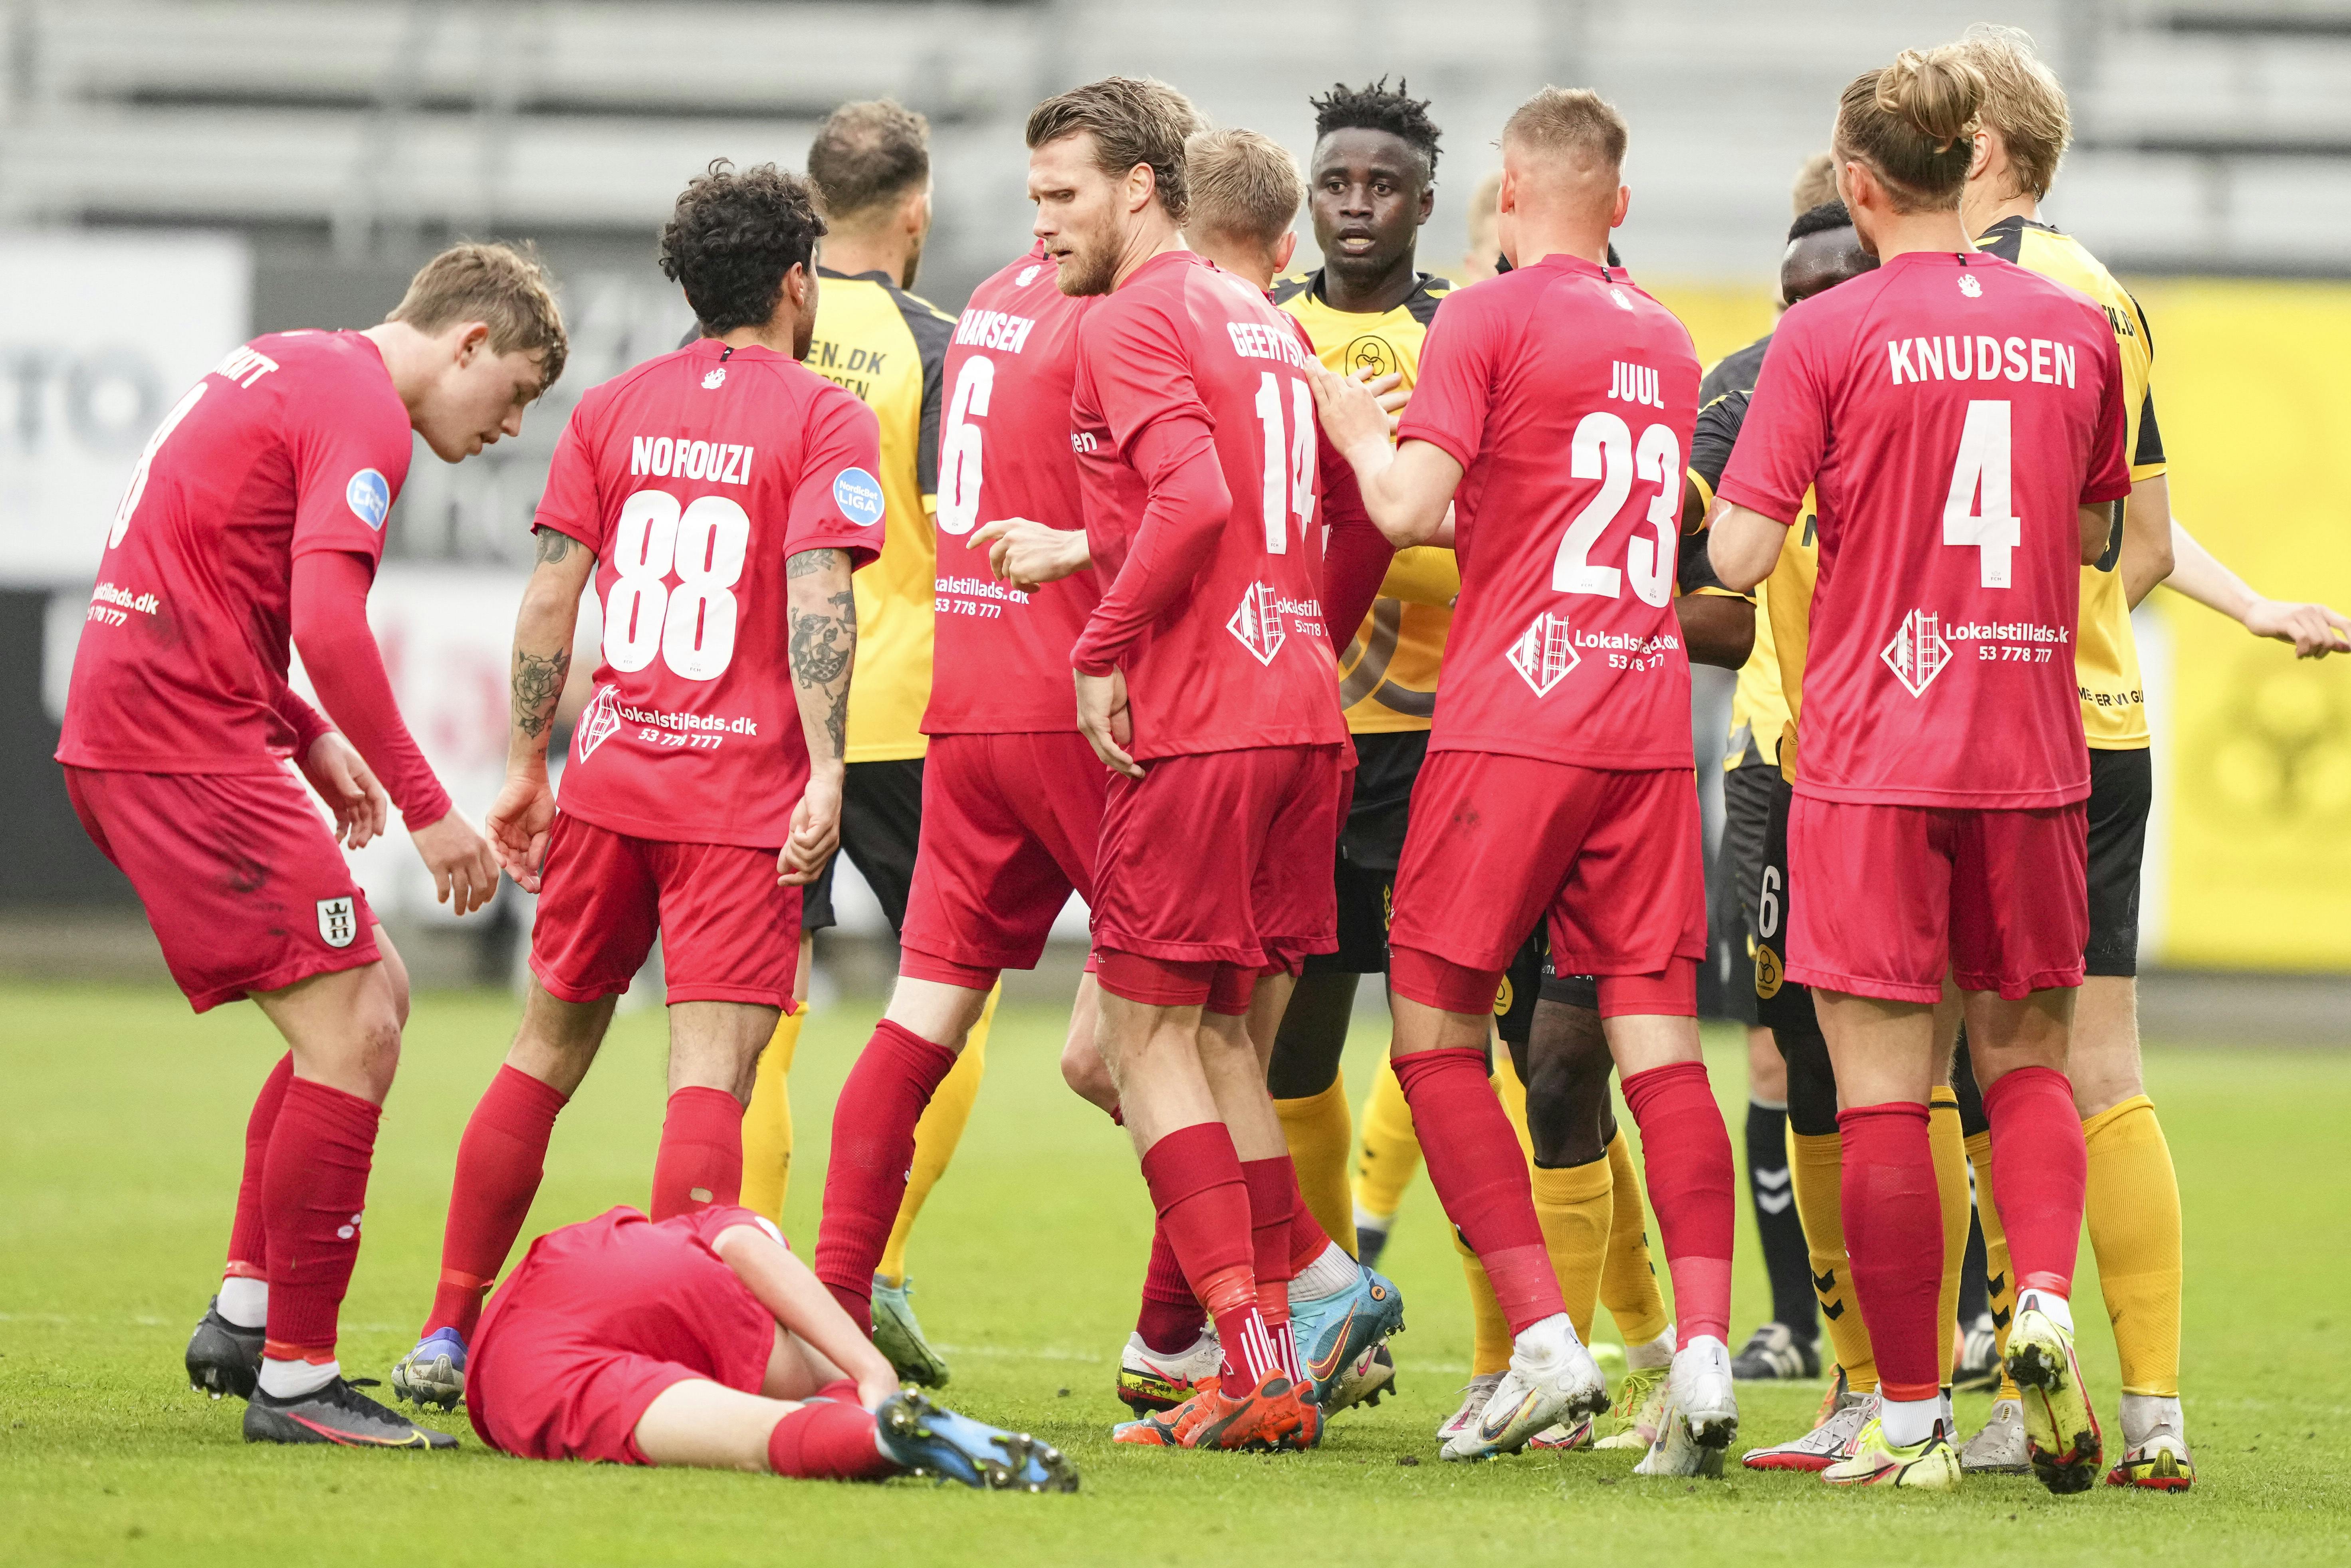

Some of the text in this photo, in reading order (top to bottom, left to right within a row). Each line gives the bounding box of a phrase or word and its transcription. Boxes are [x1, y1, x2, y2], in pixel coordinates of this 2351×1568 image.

[955, 309, 1035, 354] HANSEN
[1608, 360, 1664, 410] JUUL
[1888, 336, 2075, 389] KNUDSEN
[936, 355, 994, 535] 6
[1255, 371, 1316, 555] 14
[839, 479, 878, 500] NordicBet
[839, 490, 877, 514] LIGA
[1552, 412, 1681, 608] 23
[1943, 400, 2021, 588] 4
[603, 489, 750, 681] 88
[953, 600, 976, 616] 778
[979, 603, 1001, 619] 777
[1609, 654, 1627, 669] 53
[1979, 646, 1996, 660] 53
[2002, 647, 2031, 662] 778
[2095, 694, 2112, 706] ER
[2112, 693, 2129, 705] VI
[639, 728, 659, 742] 53
[690, 734, 723, 749] 777
[1759, 865, 1781, 938] 6
